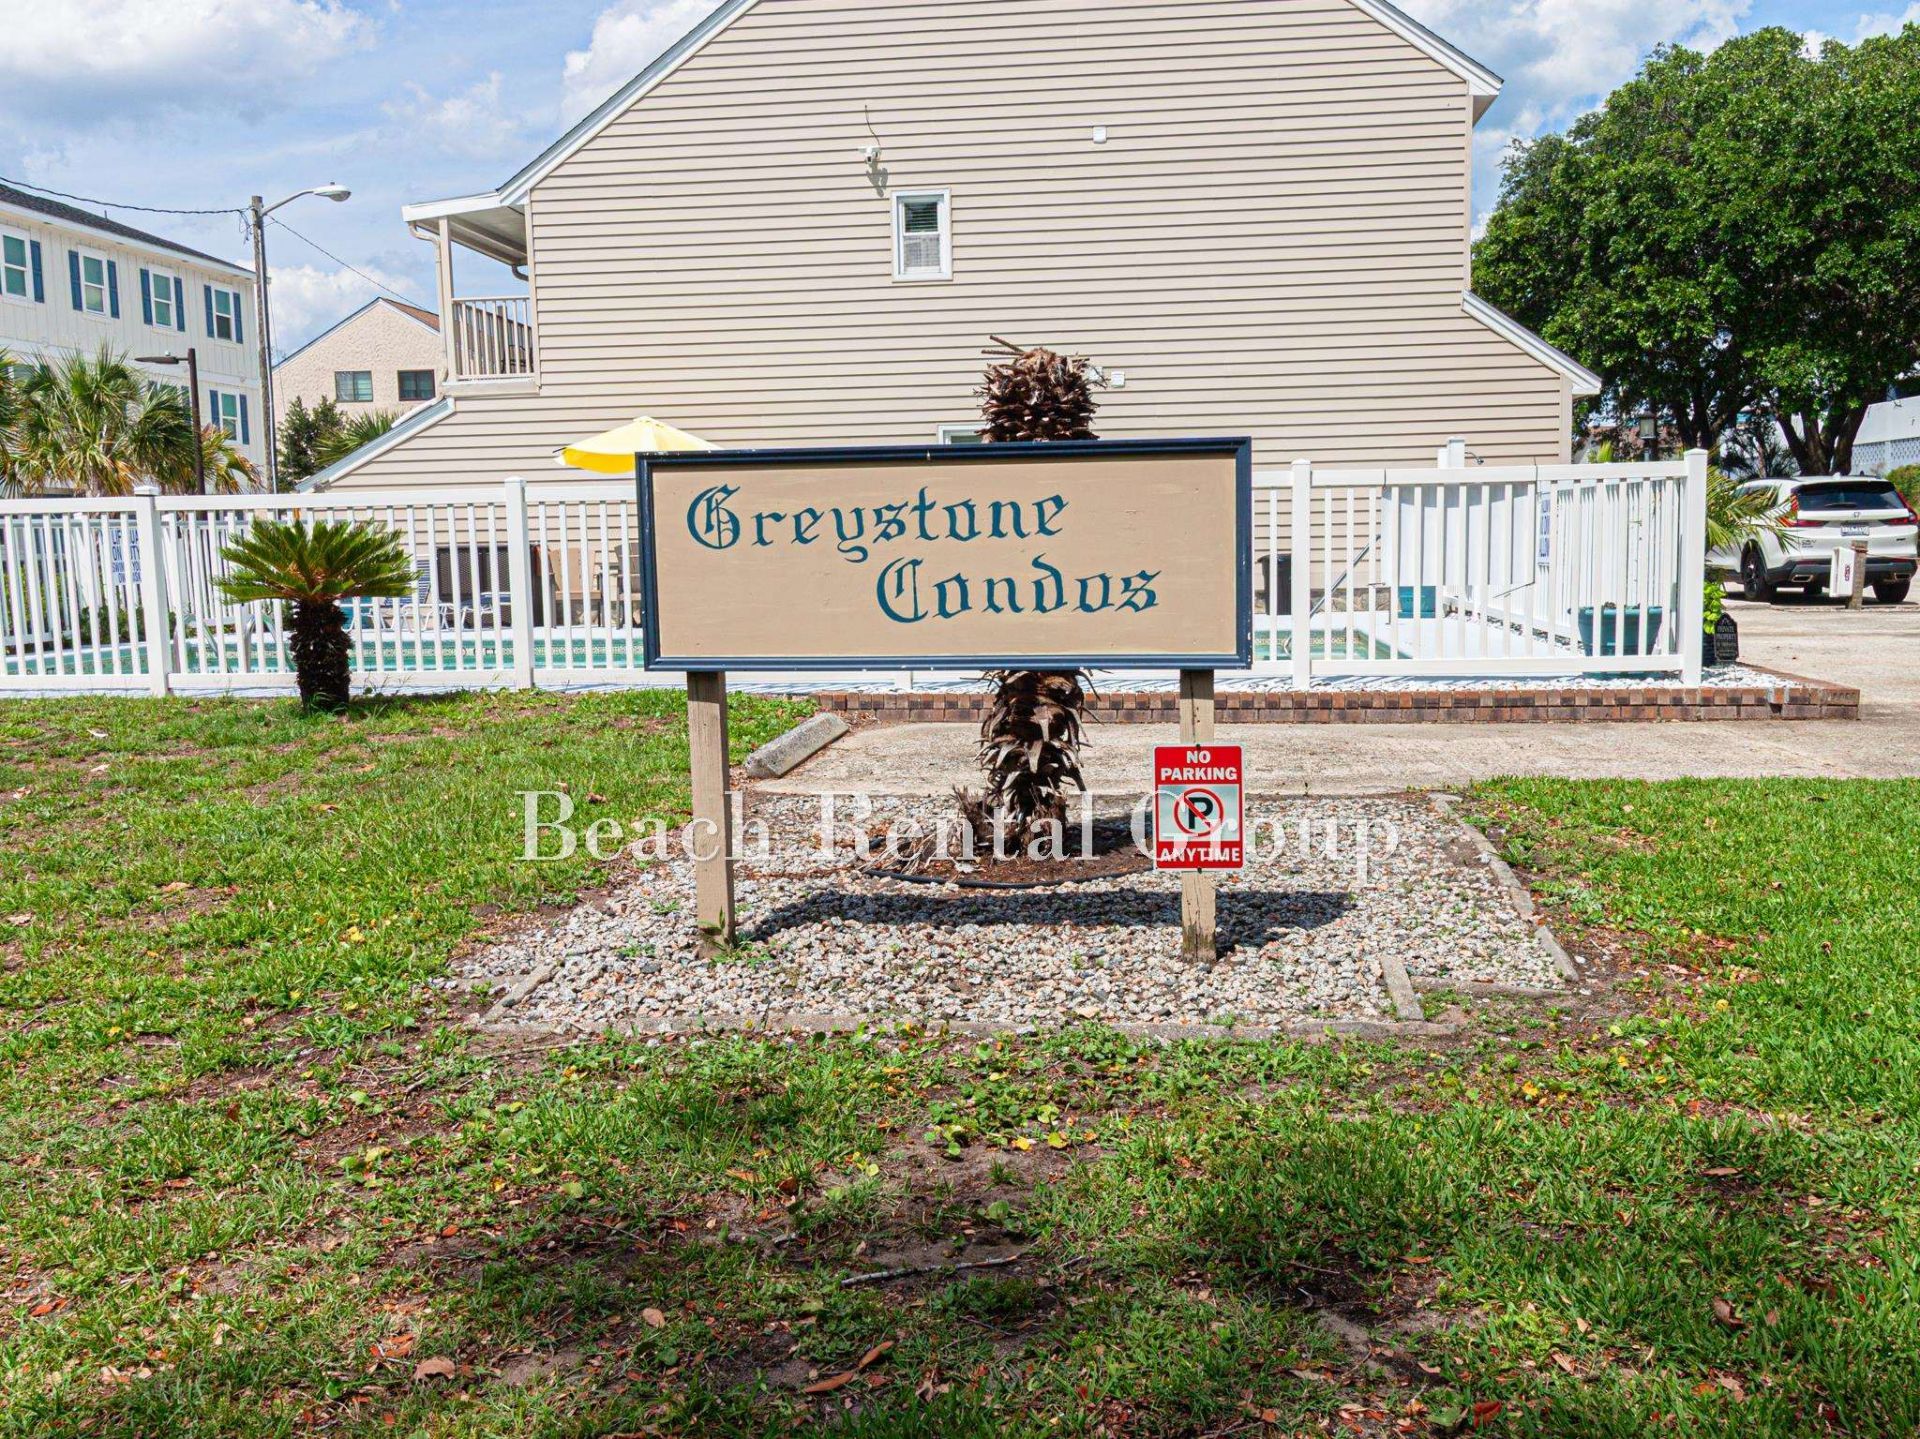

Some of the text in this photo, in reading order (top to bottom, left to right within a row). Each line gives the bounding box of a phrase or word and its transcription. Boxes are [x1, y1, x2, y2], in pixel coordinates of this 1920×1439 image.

[687, 483, 1069, 564] Greystone
[876, 553, 1162, 624] Condos
[1186, 750, 1211, 764] NO
[1160, 767, 1238, 780] PARKING
[1159, 847, 1241, 862] ANYTIME
